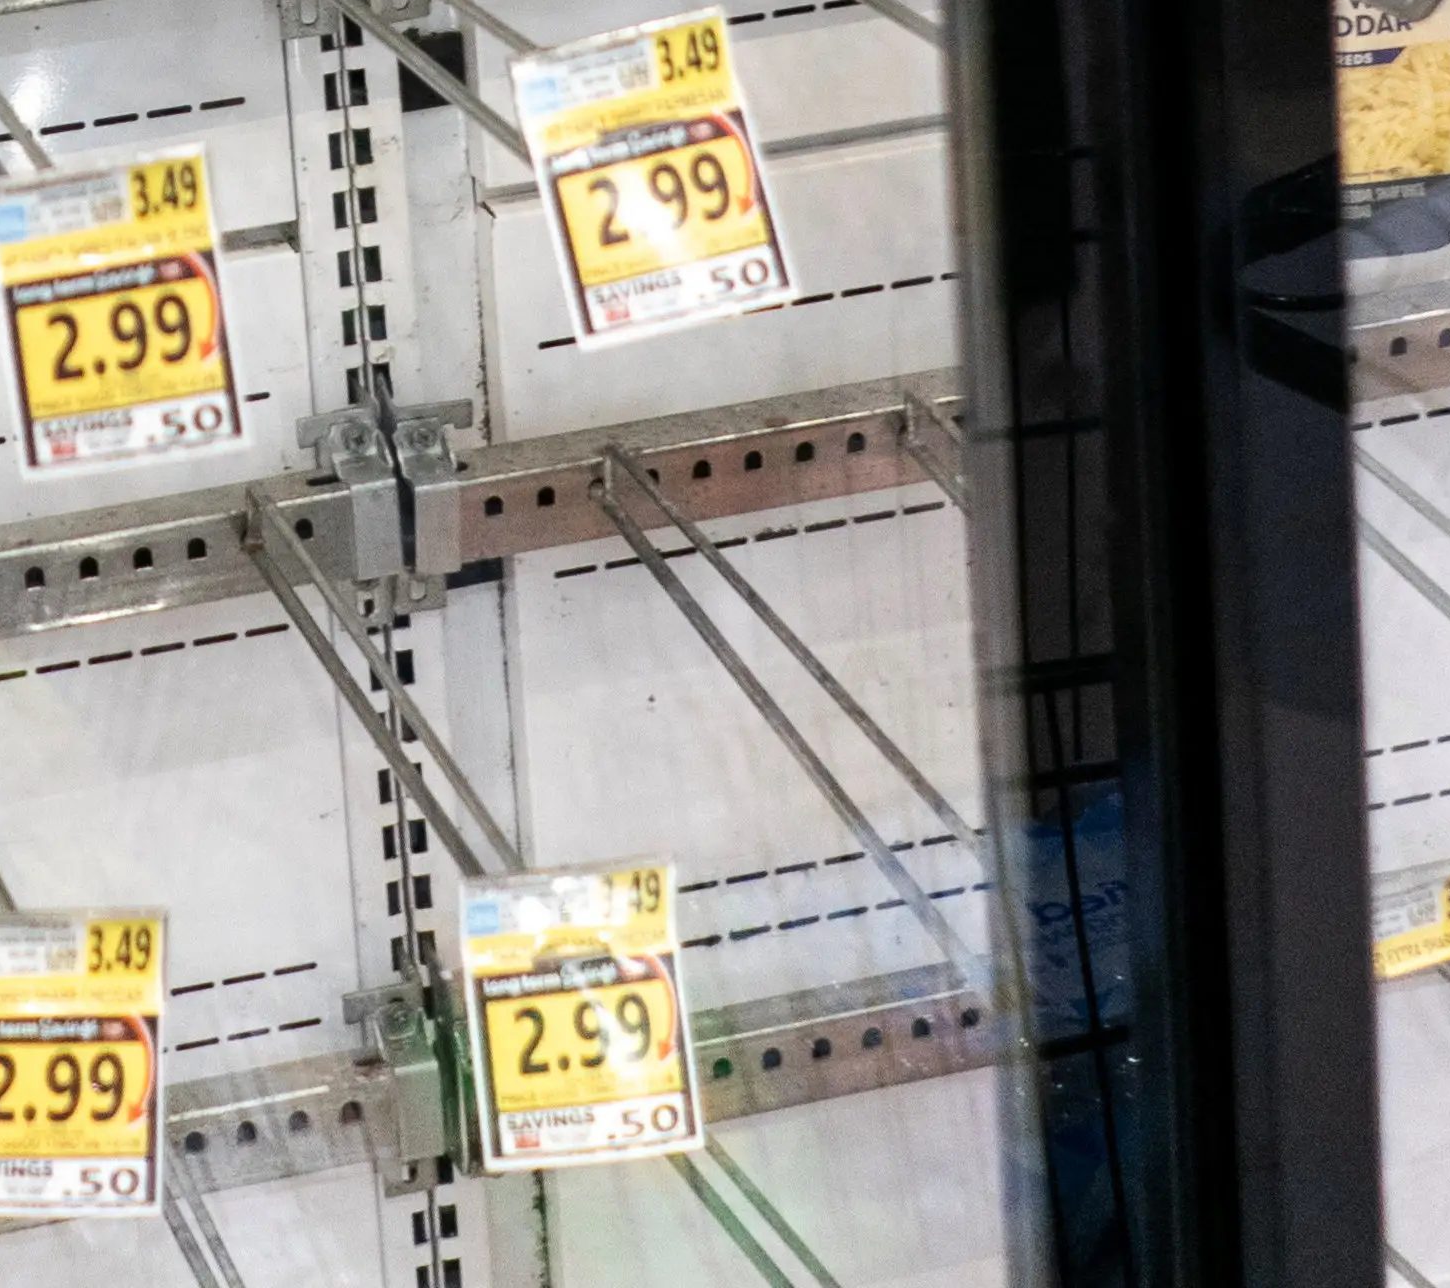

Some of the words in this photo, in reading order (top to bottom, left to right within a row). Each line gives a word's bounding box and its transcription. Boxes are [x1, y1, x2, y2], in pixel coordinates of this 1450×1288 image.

[657, 27, 721, 82] 3.49
[133, 161, 199, 218] 3.49
[594, 272, 683, 305] SAVINGS
[48, 292, 192, 382] 2.99
[147, 403, 223, 443] .50
[88, 926, 152, 973] 3.49
[514, 992, 652, 1077] 2.99
[506, 1107, 596, 1131] SAVINGS
[606, 1104, 679, 1141] .50
[63, 1167, 140, 1198] .50
